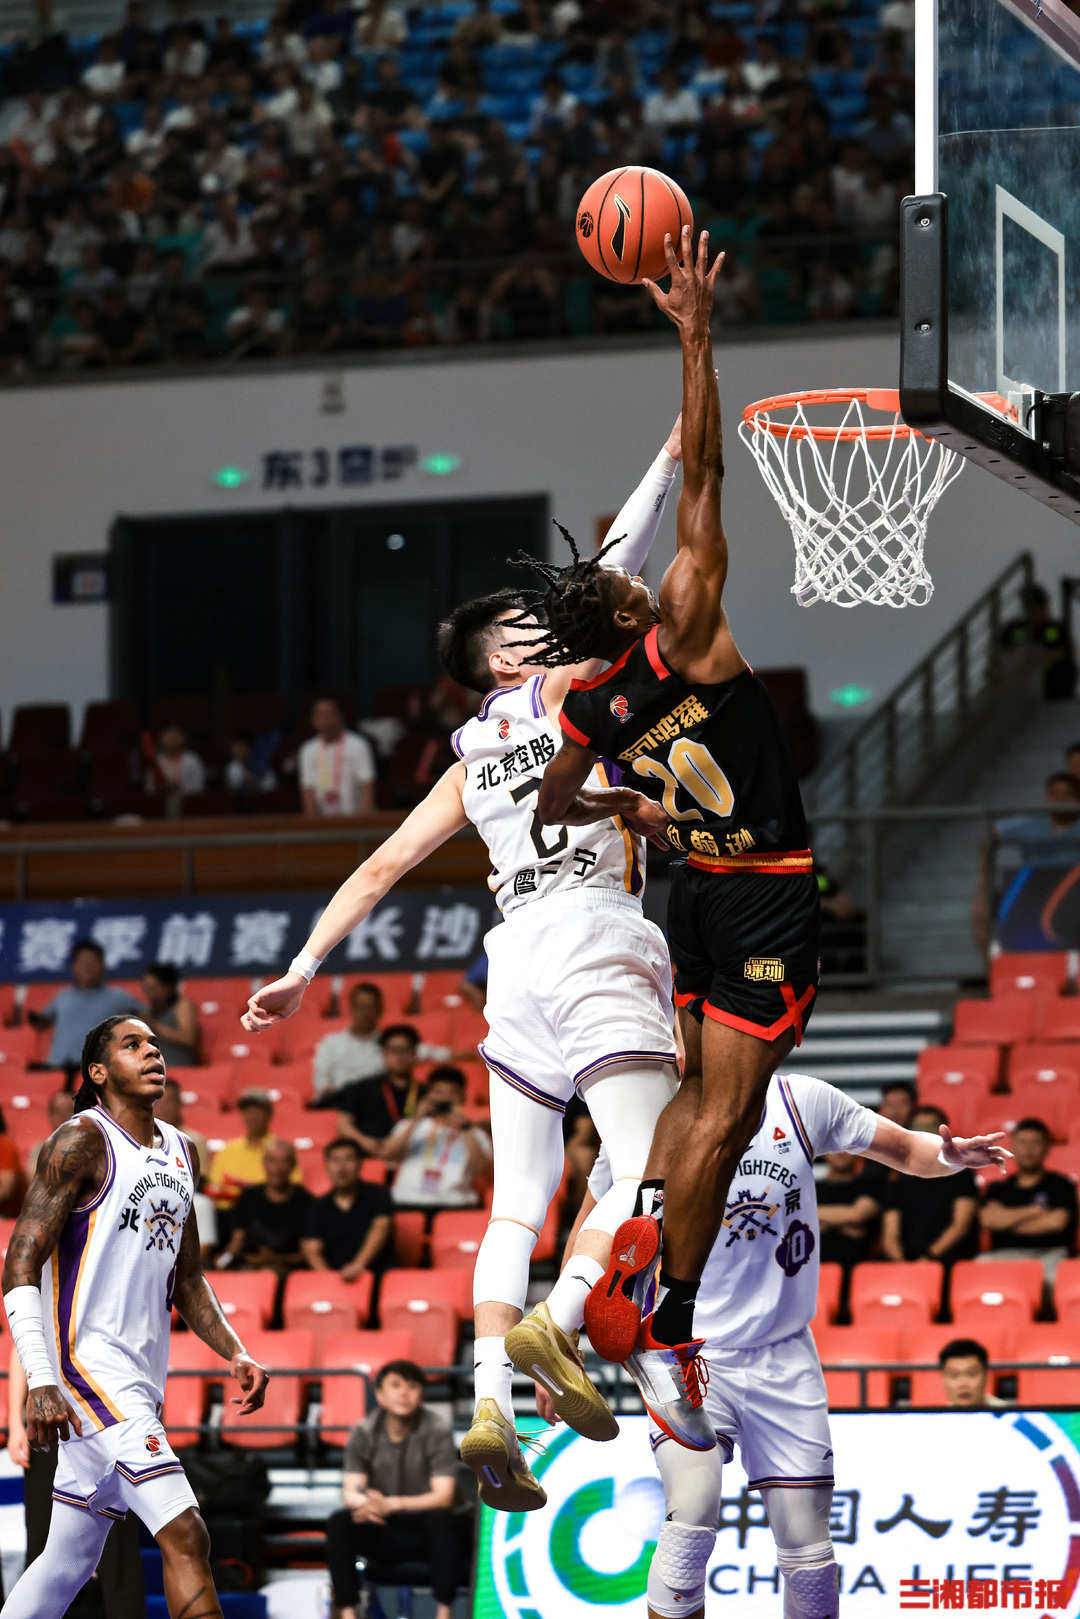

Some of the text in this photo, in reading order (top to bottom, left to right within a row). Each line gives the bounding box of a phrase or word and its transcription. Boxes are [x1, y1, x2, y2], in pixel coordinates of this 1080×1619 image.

[476, 733, 556, 791] 北京控股
[632, 736, 735, 822] 20
[0, 909, 291, 975] 赛季前赛
[746, 964, 782, 980] 深圳
[738, 1159, 798, 1188] IGHTERS
[128, 1174, 156, 1206] ROYAL
[784, 1188, 801, 1216] 京
[118, 1208, 140, 1233] 北
[709, 1564, 886, 1594] CHA
